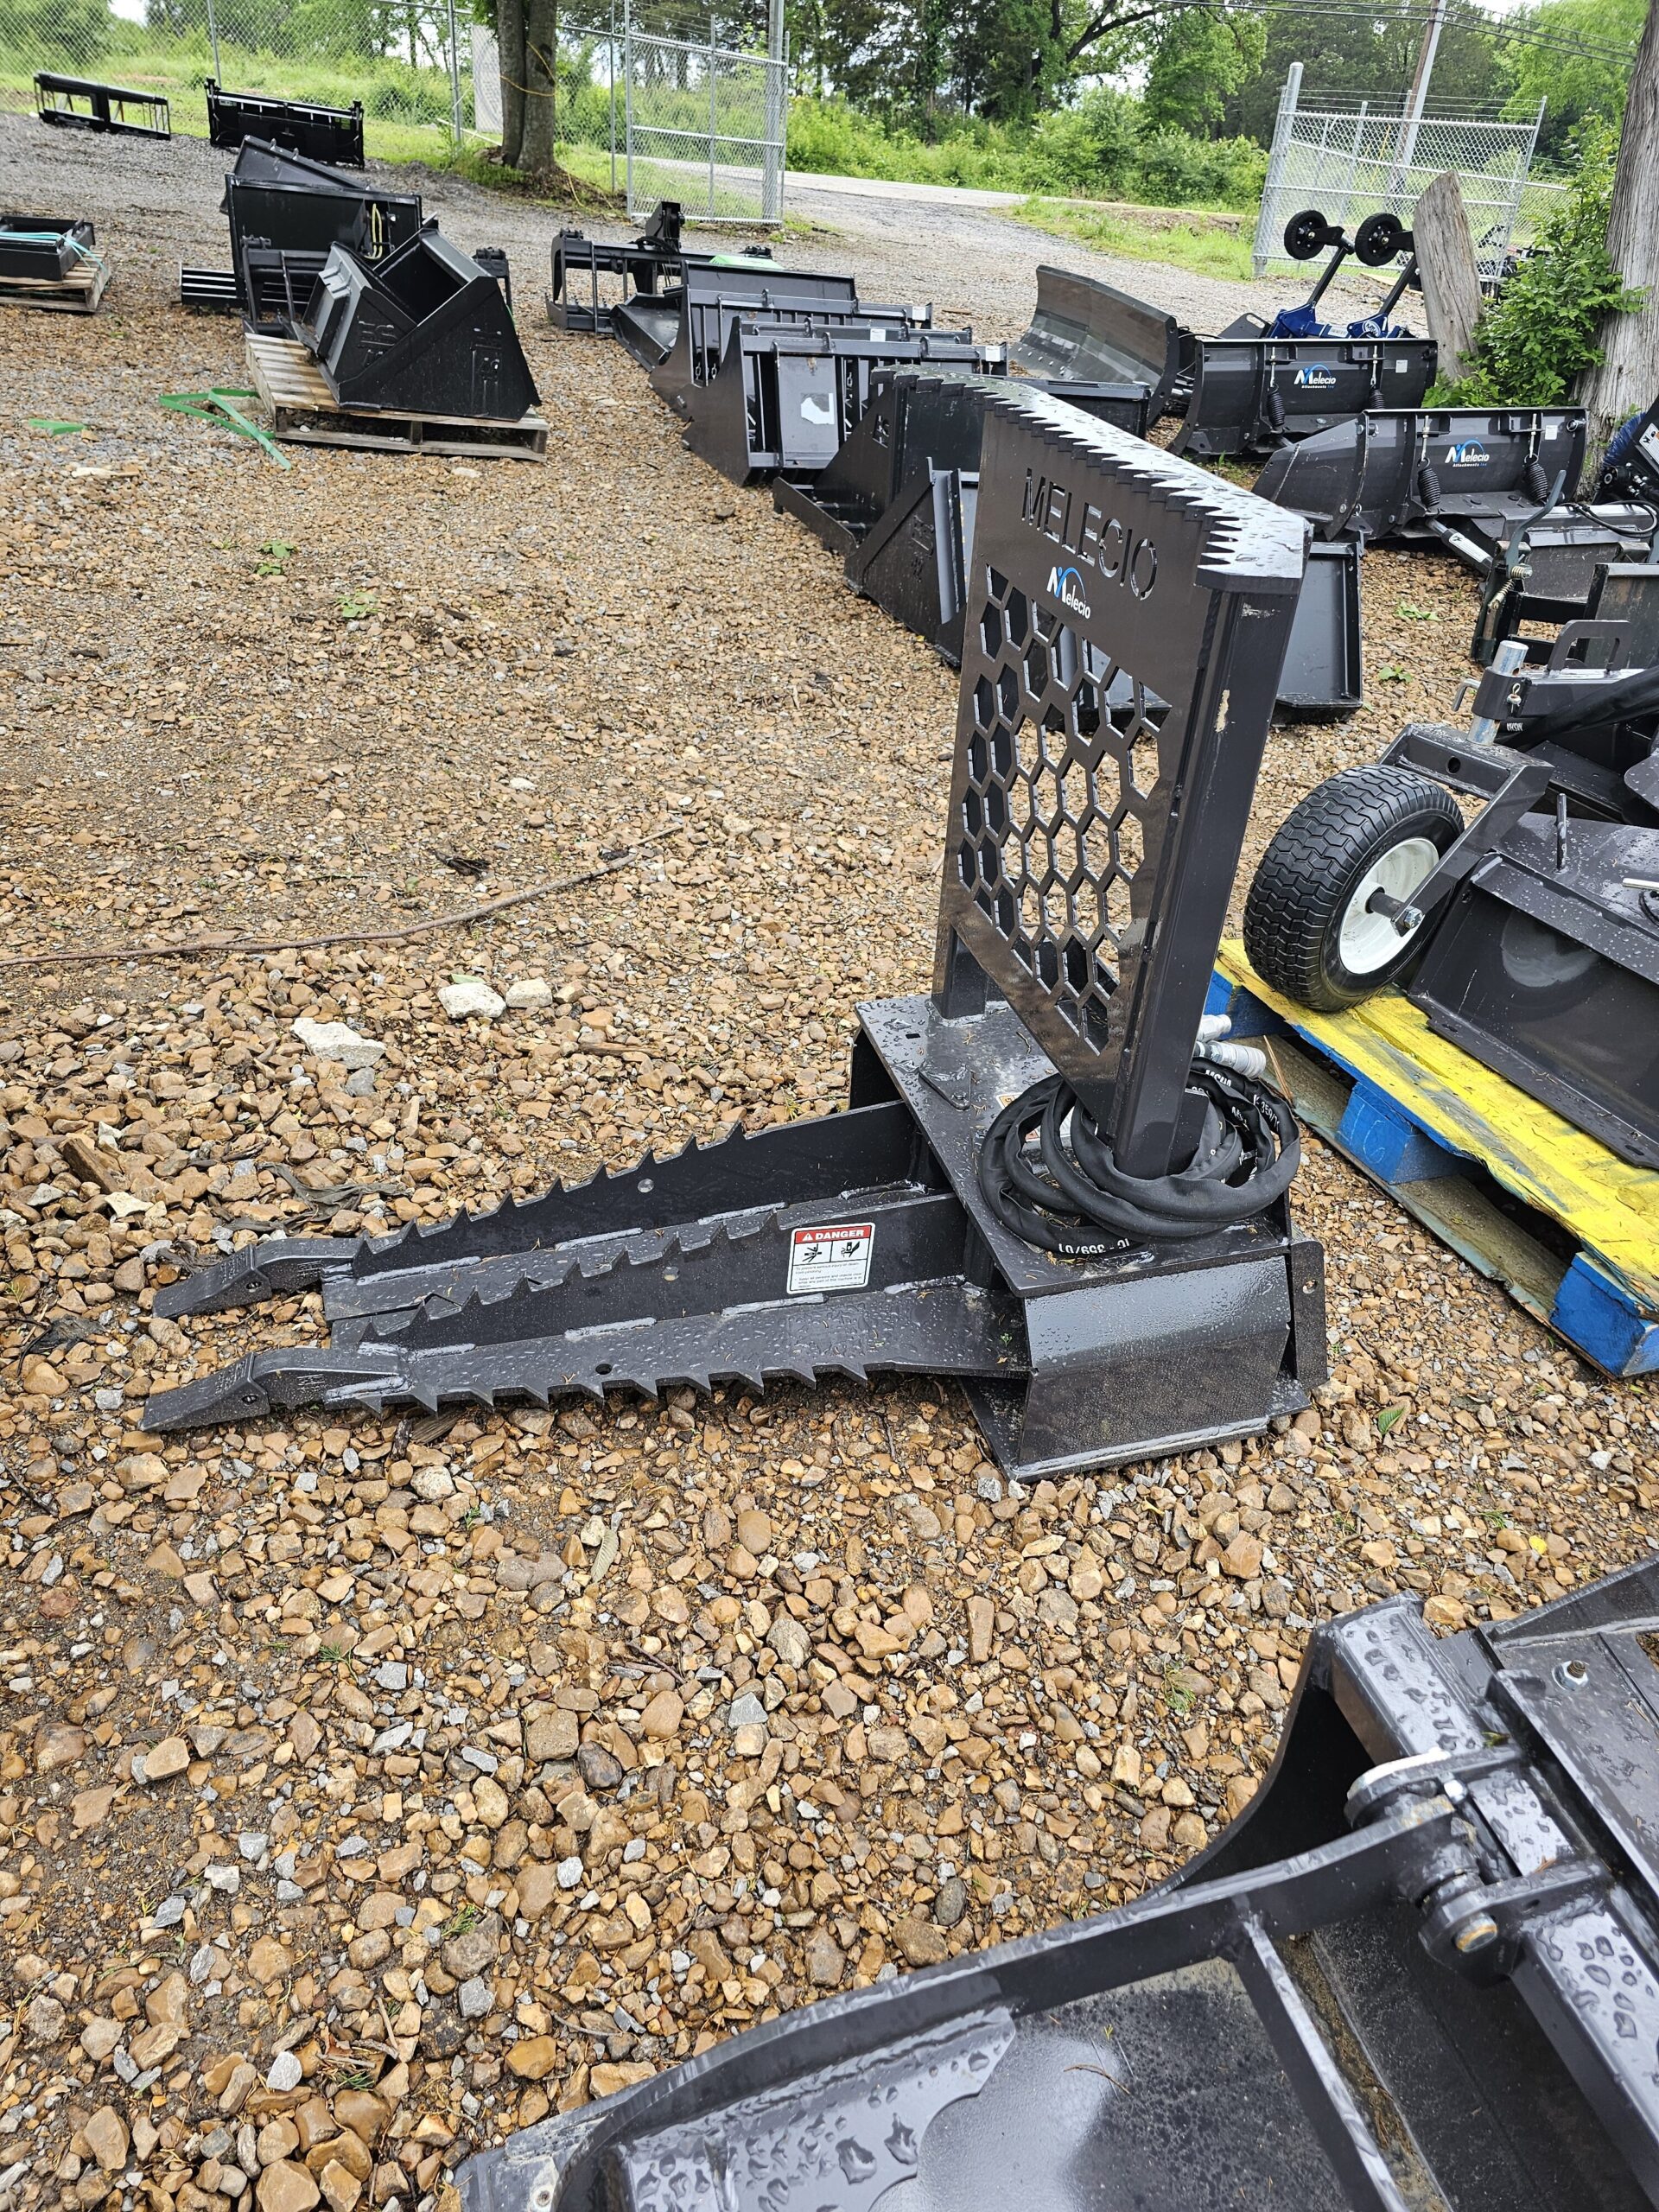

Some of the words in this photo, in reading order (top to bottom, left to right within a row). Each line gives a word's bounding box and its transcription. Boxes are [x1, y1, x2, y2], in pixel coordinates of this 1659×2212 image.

[1294, 367, 1337, 385] Melecio
[1445, 442, 1490, 464] Melecio
[1021, 467, 1158, 601] MELECIO
[1046, 566, 1091, 620] Melecio
[815, 1229, 864, 1241] DANGER
